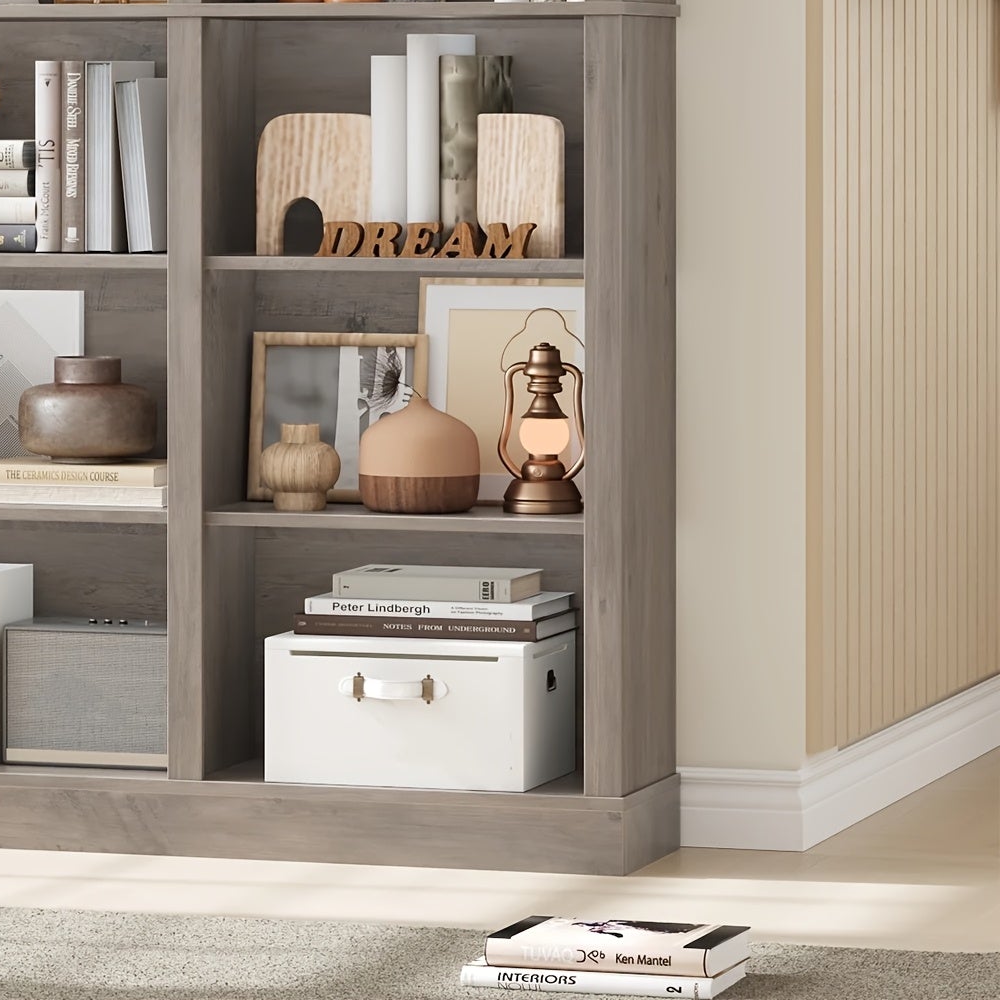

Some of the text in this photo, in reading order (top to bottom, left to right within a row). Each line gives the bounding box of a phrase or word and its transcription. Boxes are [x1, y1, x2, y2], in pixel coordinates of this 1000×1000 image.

[38, 138, 56, 168] 'TIS
[40, 182, 50, 240] Frank McCourt
[314, 221, 537, 259] DREAM
[6, 470, 119, 482] THE CERAMICS DESIGN COURSE
[332, 602, 431, 616] Peter Lindbergh
[448, 625, 516, 634] UNDERGROUND
[615, 953, 672, 967] Ken Mantel
[497, 972, 577, 985] INTERIORS
[666, 985, 682, 994] 2
